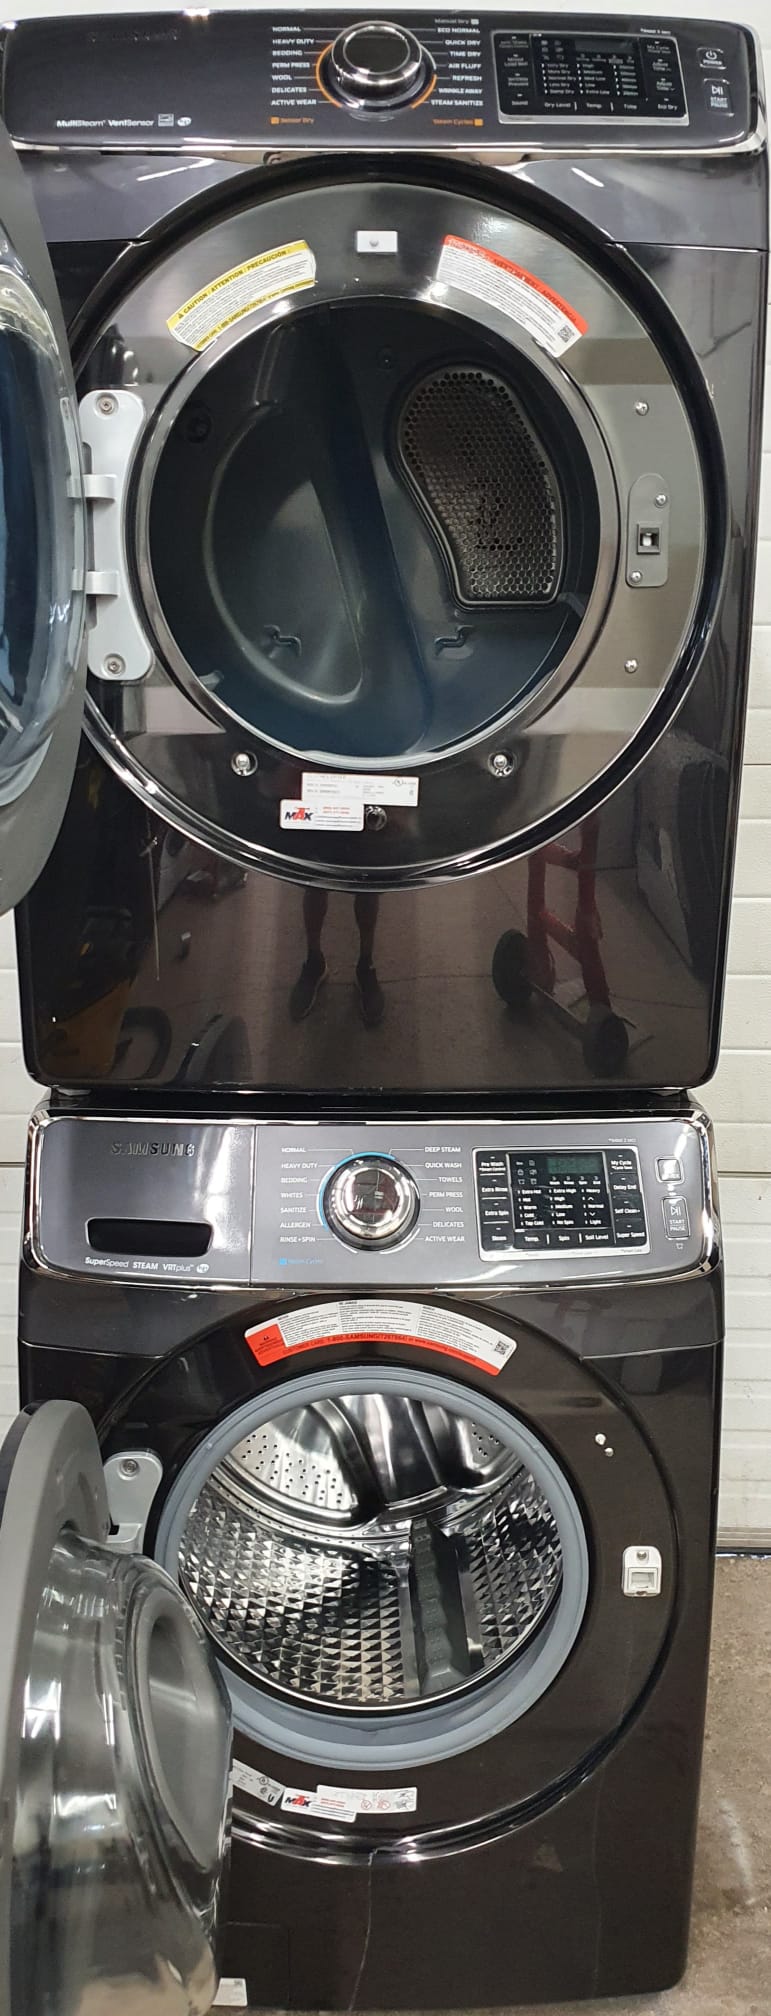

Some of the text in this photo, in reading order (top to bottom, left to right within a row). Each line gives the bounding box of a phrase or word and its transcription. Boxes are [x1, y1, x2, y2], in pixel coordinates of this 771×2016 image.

[183, 292, 208, 314] CAUTION
[211, 270, 243, 292] ATTENTION
[247, 250, 287, 271] PRECAUCIÓN
[111, 1142, 195, 1156] SAMSUNG
[85, 1257, 129, 1269] SuperSpeed
[132, 1262, 159, 1270] STEAM
